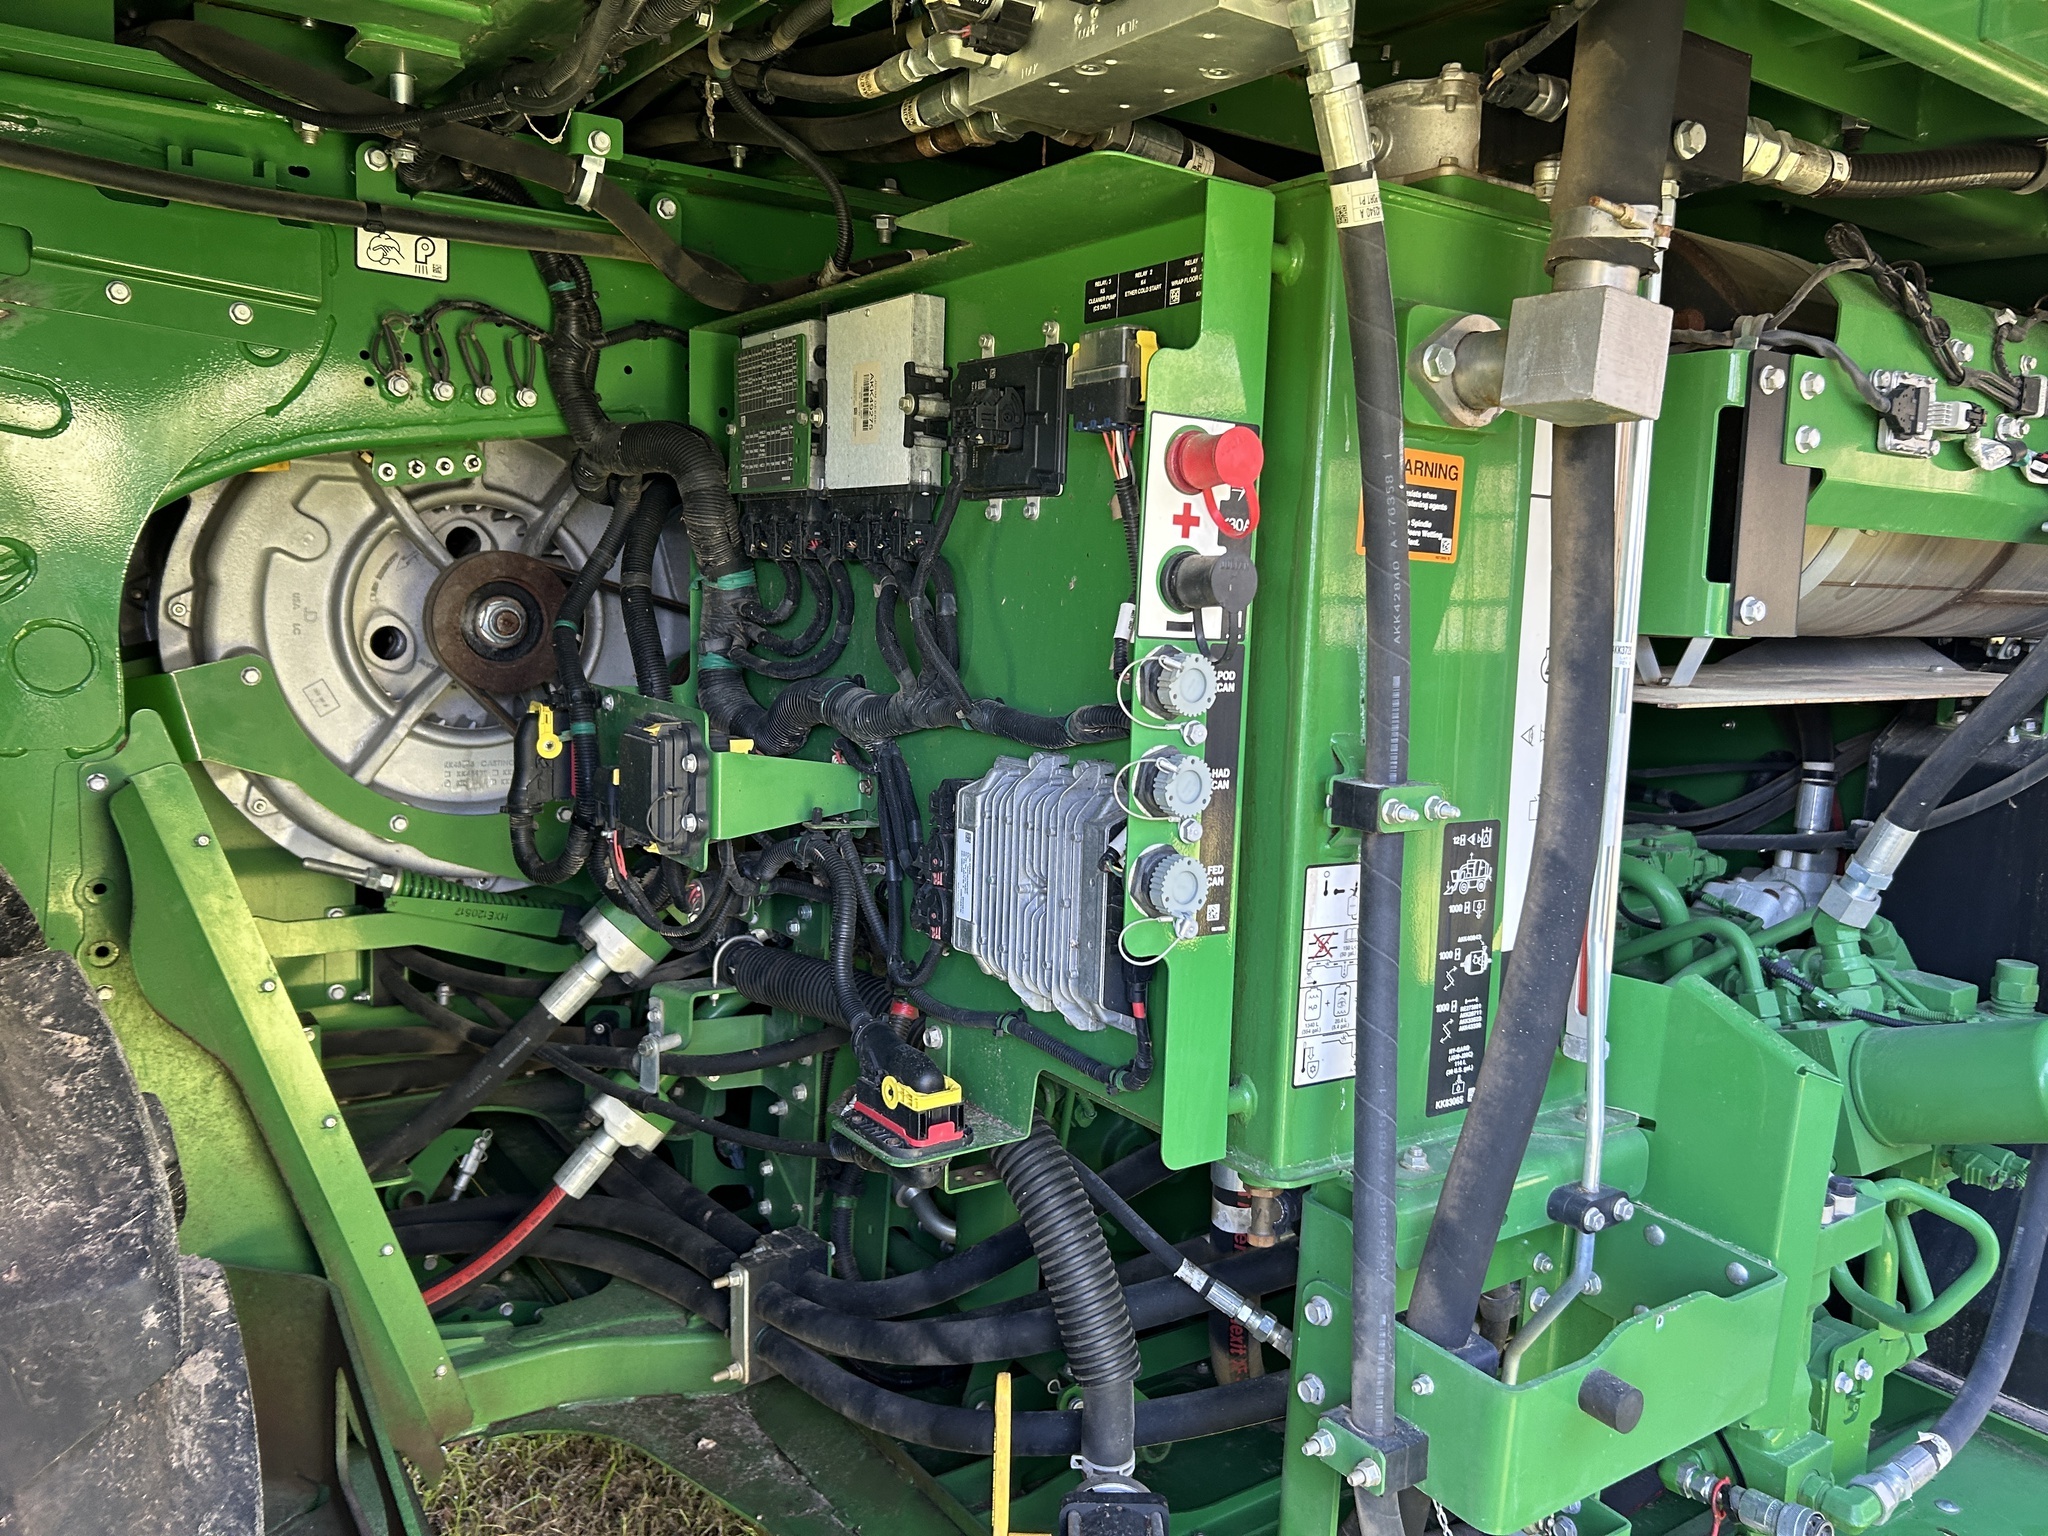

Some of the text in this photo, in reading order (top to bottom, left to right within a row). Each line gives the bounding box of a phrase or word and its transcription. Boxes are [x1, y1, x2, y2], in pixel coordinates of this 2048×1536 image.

[1359, 196, 1366, 205] P1
[1360, 208, 1364, 218] A
[1184, 257, 1199, 266] RELAY
[1135, 270, 1148, 279] RELAY
[1171, 278, 1184, 286] WRAP
[1184, 275, 1198, 284] FLOOR
[1124, 283, 1162, 297] ETHER COLD START
[1088, 293, 1116, 305] CLEANER PUMP
[1404, 459, 1459, 482] ARNING
[1406, 490, 1437, 500] xists when
[1406, 499, 1448, 511] istening agents
[1411, 518, 1432, 528] Spindle
[1422, 530, 1443, 540] Wetting
[292, 592, 301, 610] USA
[1217, 671, 1236, 681] POD
[1217, 682, 1235, 693] CAN
[1212, 768, 1230, 778] HAD
[1212, 780, 1229, 790] CAN
[1453, 836, 1460, 845] 12
[1207, 865, 1224, 875] FED
[1207, 876, 1224, 886] CAN
[1449, 904, 1463, 913] 1000
[1439, 951, 1453, 960] 1000
[1436, 1003, 1450, 1013] 1000
[1230, 1319, 1247, 1356] exit
